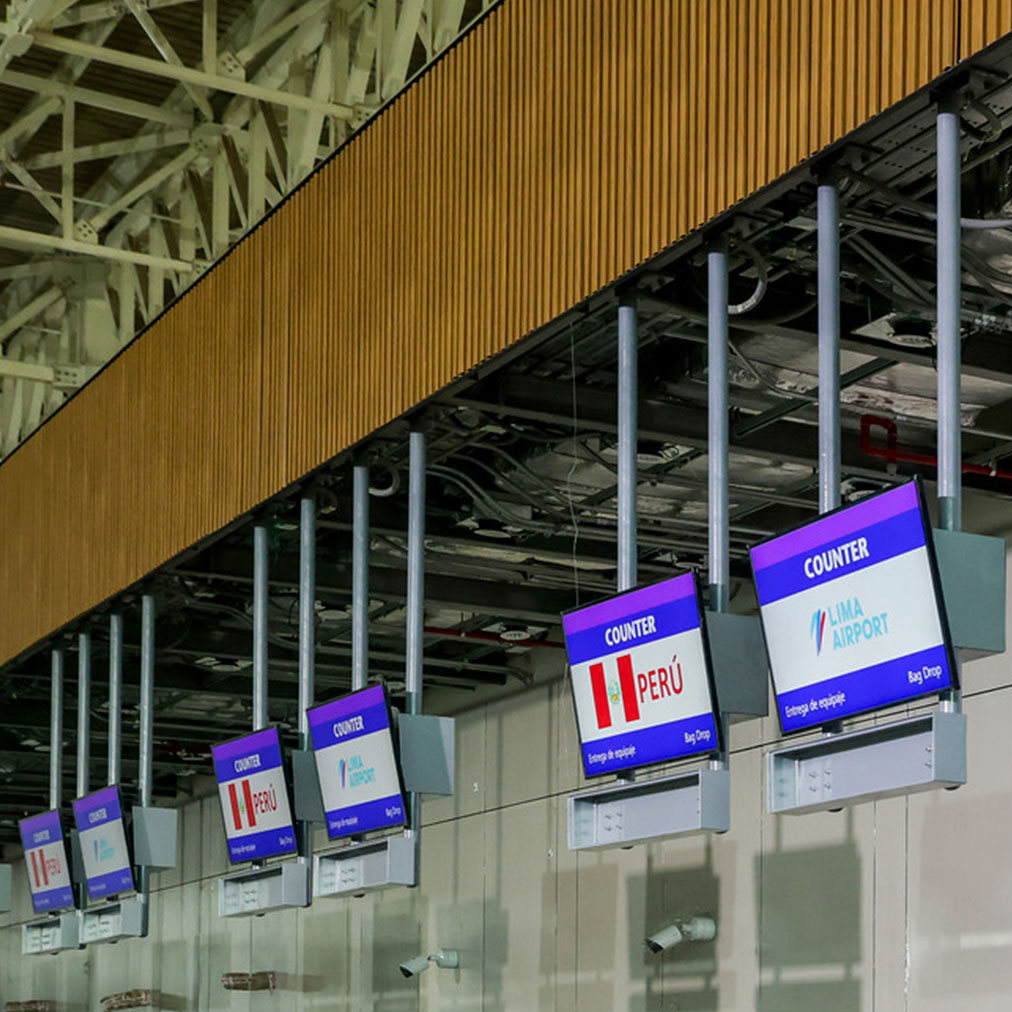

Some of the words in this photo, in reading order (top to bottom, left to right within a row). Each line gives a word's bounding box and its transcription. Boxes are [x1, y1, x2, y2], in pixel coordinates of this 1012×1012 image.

[804, 537, 870, 579] COUNTER
[828, 597, 864, 627] LIMA
[605, 615, 657, 646] COUNTER
[833, 612, 889, 650] AIRPORT
[637, 654, 684, 703] PERÚ
[908, 671, 923, 685] Bag
[922, 666, 942, 679] Drop
[785, 704, 809, 718] Entrega
[809, 699, 818, 711] de
[819, 691, 846, 710] equipaje
[333, 715, 365, 738] COUNTER
[234, 753, 261, 773] COUNTER
[253, 783, 278, 814] PERÚ
